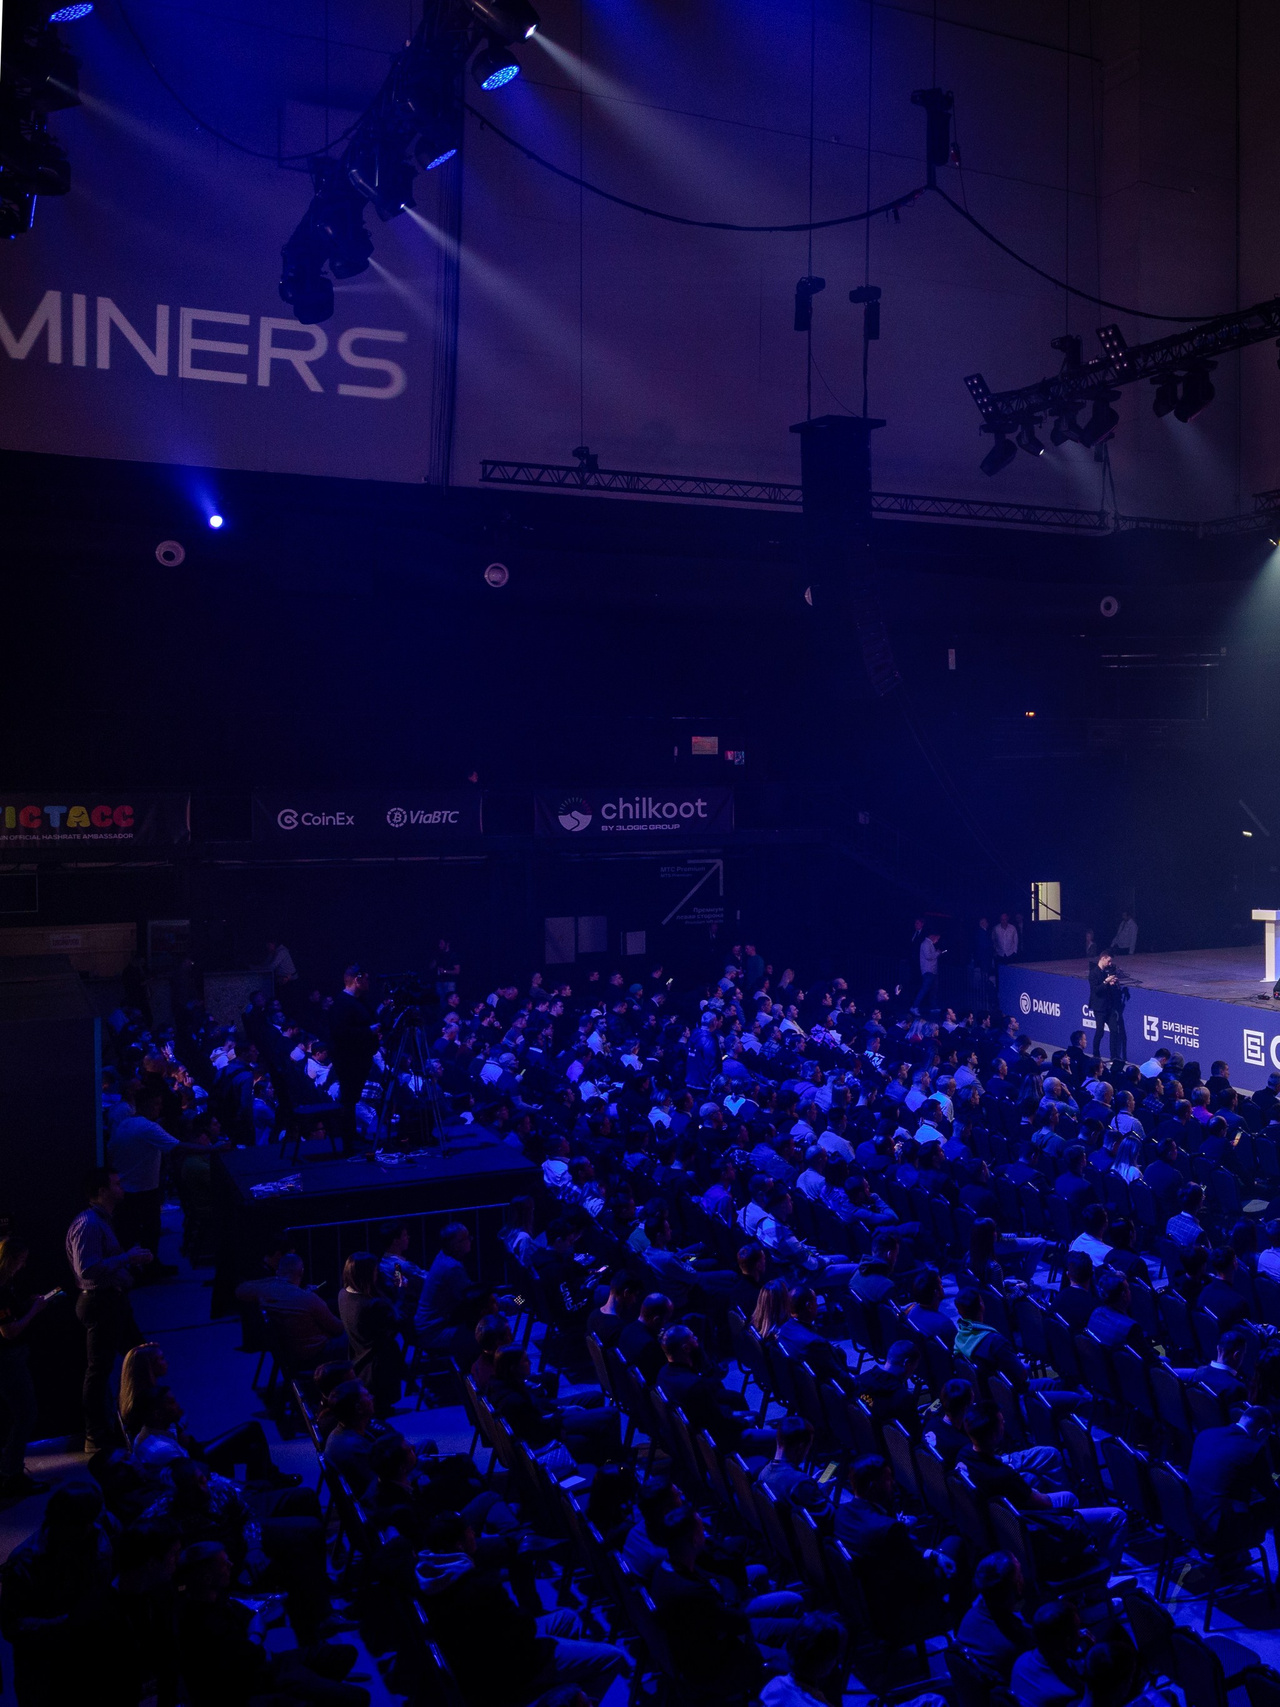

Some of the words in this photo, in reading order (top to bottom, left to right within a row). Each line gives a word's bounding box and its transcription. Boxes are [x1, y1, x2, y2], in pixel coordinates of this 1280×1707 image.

[0, 290, 408, 399] MINERS
[602, 797, 707, 819] chilkoot
[0, 805, 135, 829] ICTACC
[302, 812, 354, 825] CoinEx
[410, 811, 459, 823] ViaBTC
[1033, 999, 1060, 1016] РАКИБ
[1163, 1021, 1199, 1036] БИЗНЕС
[1174, 1035, 1200, 1048] КЛУБ
